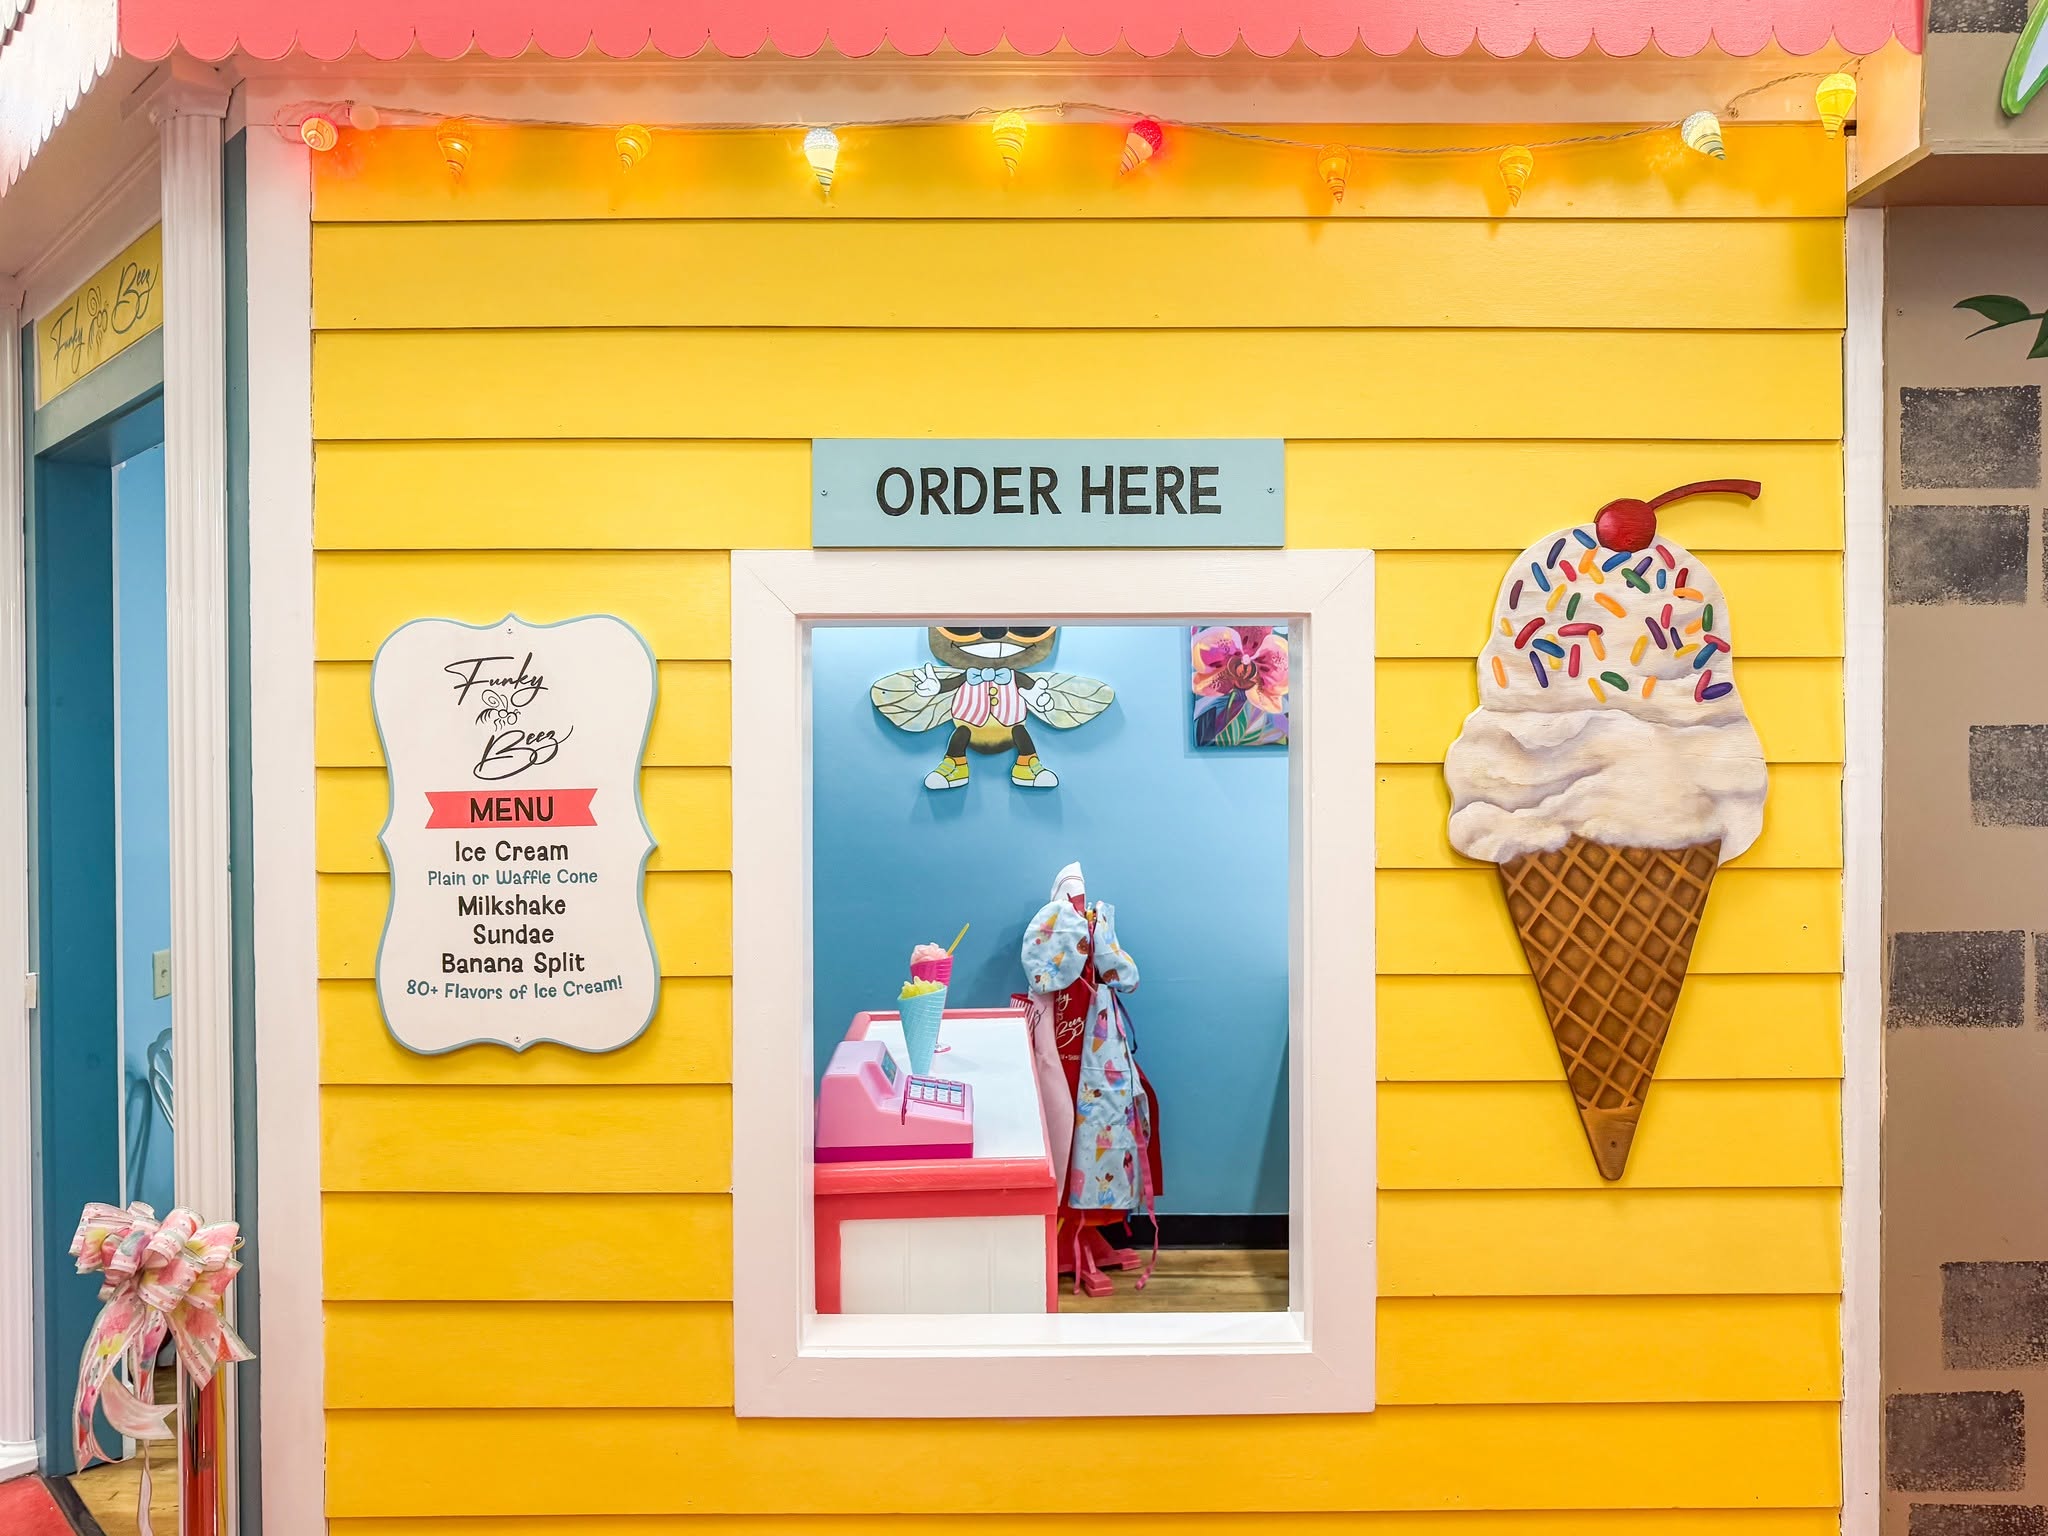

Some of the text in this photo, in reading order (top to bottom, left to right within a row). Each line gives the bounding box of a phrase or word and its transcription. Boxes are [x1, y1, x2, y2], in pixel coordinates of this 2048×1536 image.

[50, 261, 160, 382] Funky Beez
[876, 465, 1222, 516] ORDER HERE
[443, 652, 549, 708] Funky
[472, 724, 574, 781] Beez
[470, 797, 554, 823] MENU
[455, 840, 569, 862] Ice Cream
[427, 868, 598, 886] Plain or Waffle Cone
[458, 894, 567, 917] Milkshake
[473, 923, 555, 945] Sundae
[441, 951, 586, 979] Banana Split
[406, 974, 624, 1000] 80+ Flavors of Ice Cream!
